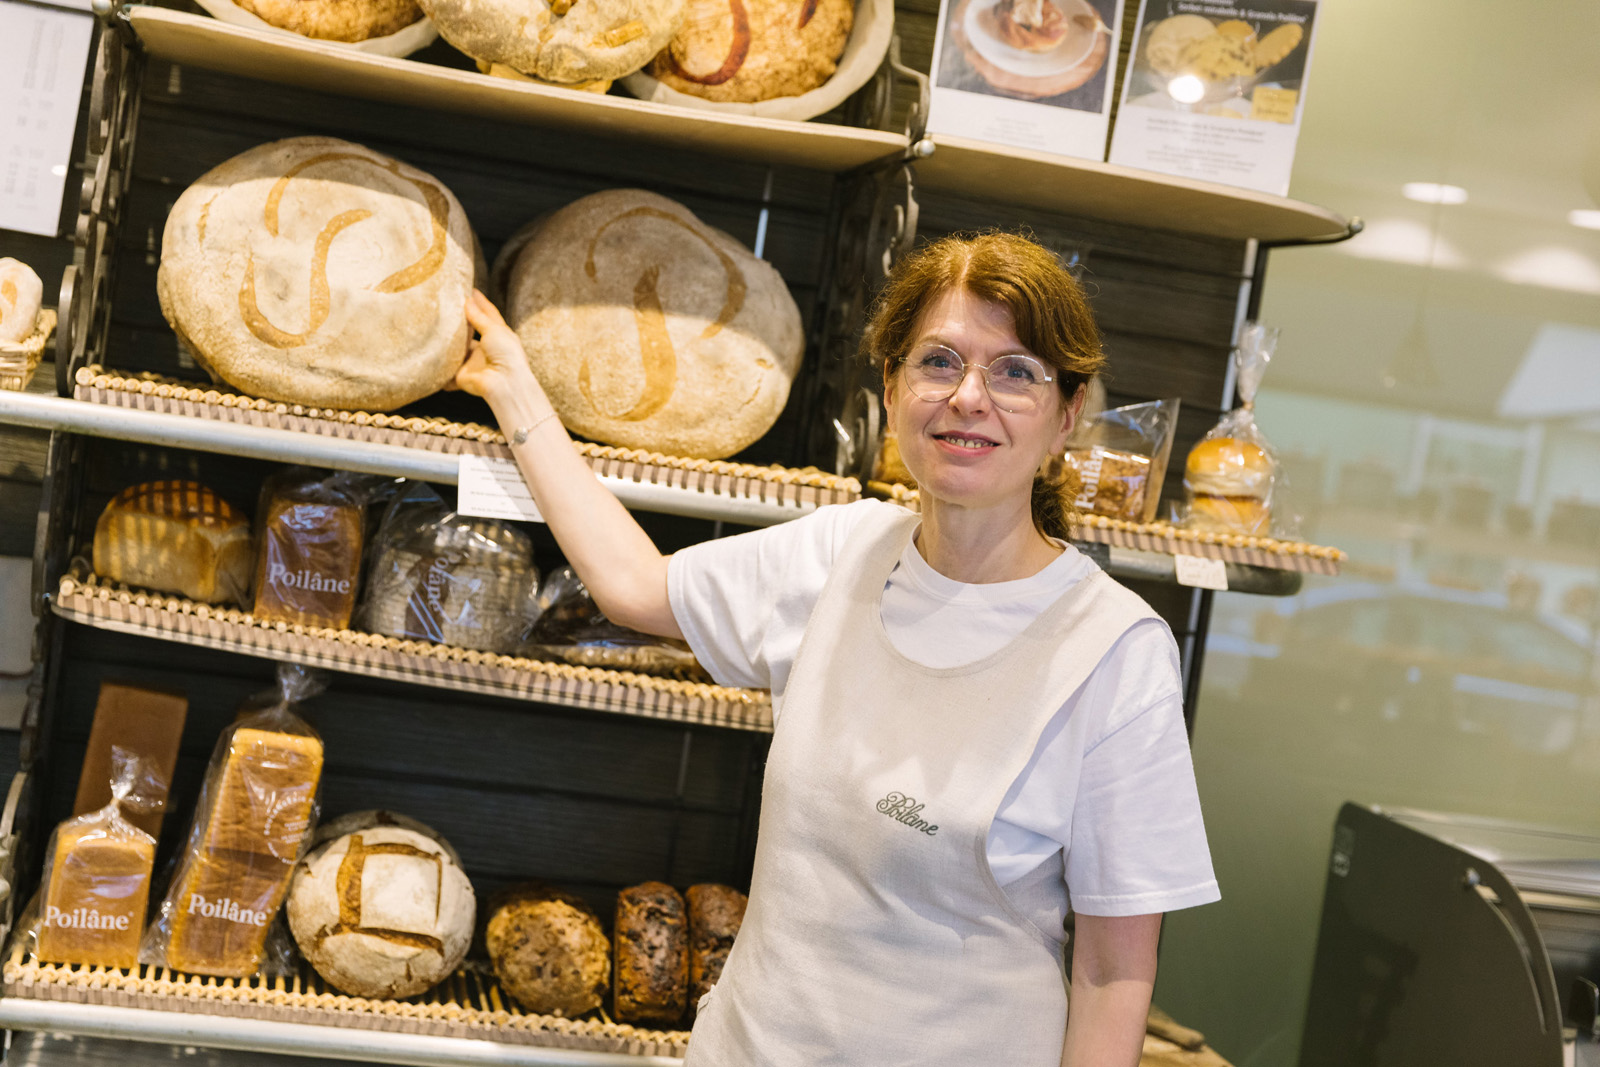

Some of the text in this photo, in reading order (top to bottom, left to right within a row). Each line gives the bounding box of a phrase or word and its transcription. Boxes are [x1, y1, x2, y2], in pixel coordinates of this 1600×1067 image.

[269, 563, 350, 594] Poilâne
[45, 905, 130, 931] Poilâne
[187, 893, 268, 927] Poilâne
